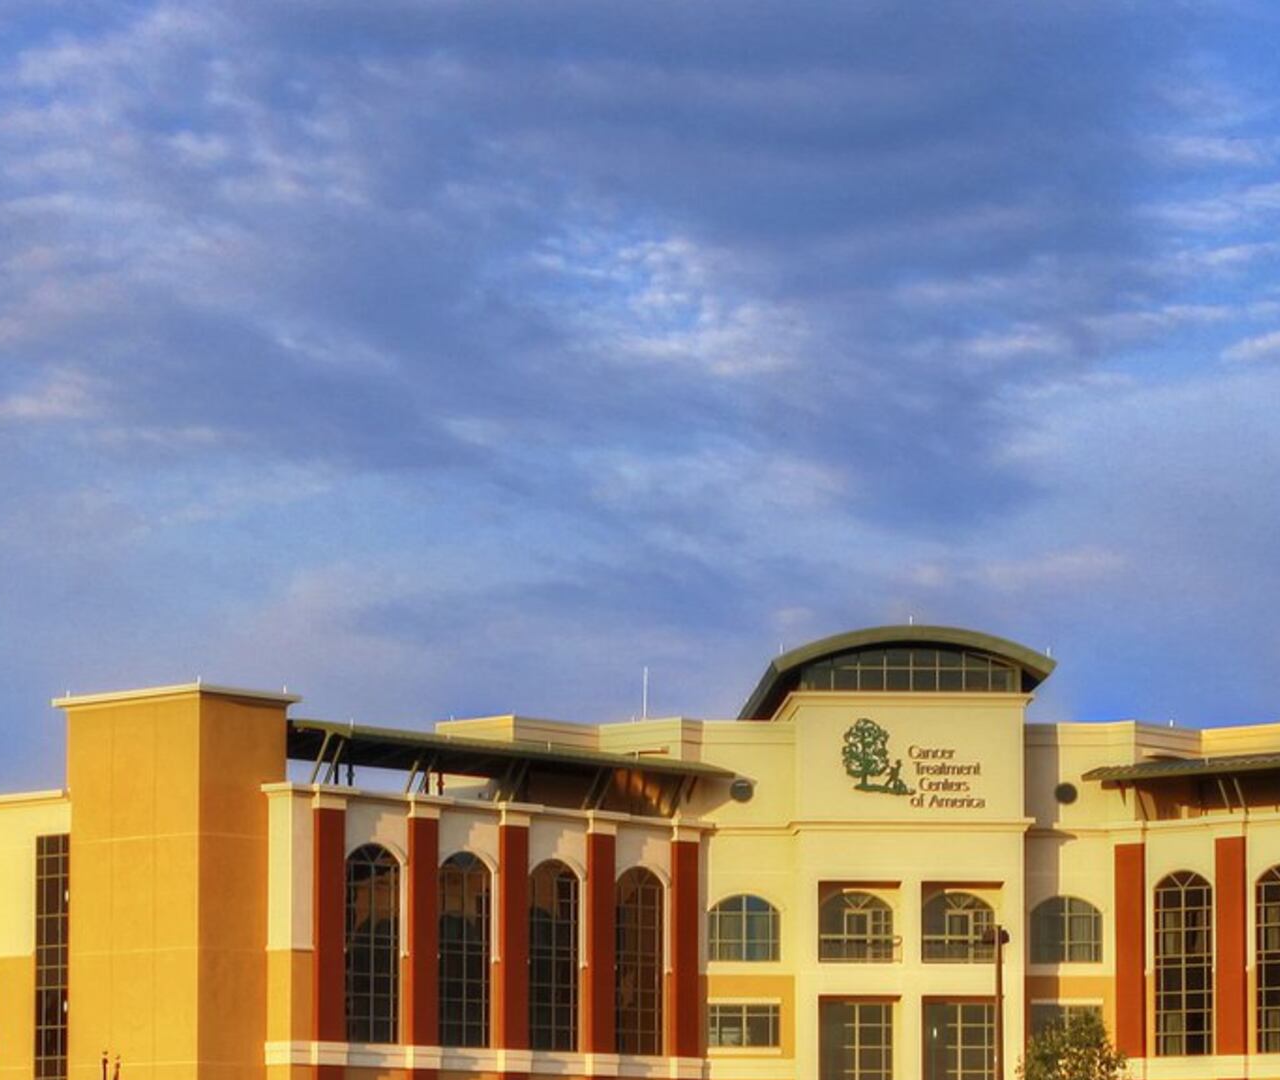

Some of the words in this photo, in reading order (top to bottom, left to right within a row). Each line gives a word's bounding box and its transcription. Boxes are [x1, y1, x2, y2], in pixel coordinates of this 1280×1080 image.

[908, 745, 955, 760] Cancer
[913, 761, 981, 775] Treatment
[919, 777, 970, 792] Centers
[910, 793, 925, 808] of
[928, 794, 986, 808] America
